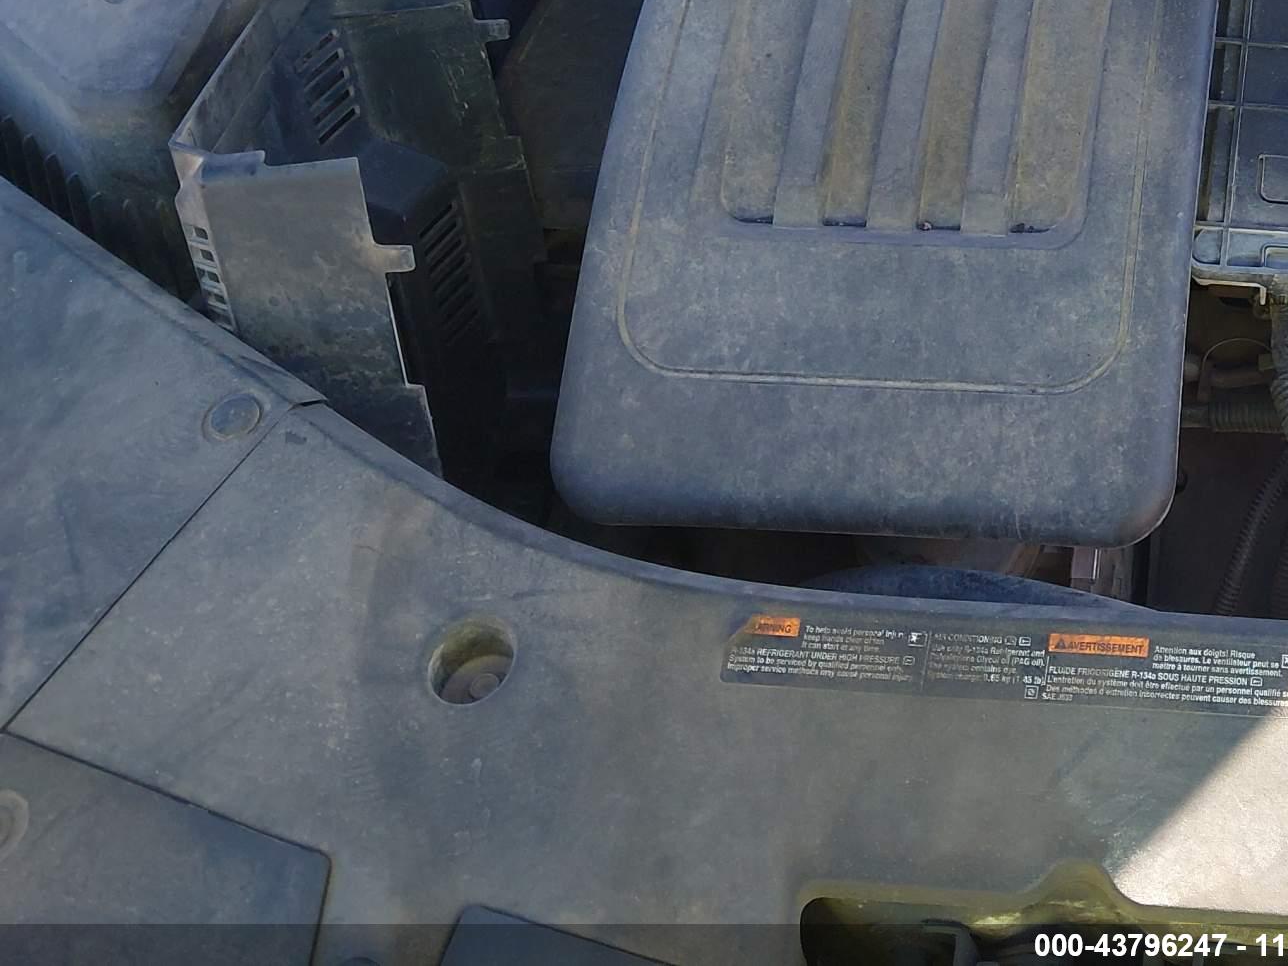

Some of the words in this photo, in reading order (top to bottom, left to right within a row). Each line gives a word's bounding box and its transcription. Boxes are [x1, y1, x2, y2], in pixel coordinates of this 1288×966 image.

[806, 625, 814, 633] To
[823, 643, 840, 651] start
[1031, 649, 1046, 658] and
[1067, 641, 1145, 654] AVERTISSEMENT
[1154, 645, 1187, 656] Attention
[1188, 648, 1202, 656] aux
[1230, 650, 1256, 661] Risque
[757, 647, 809, 658] REFRIGERANT
[811, 651, 837, 661] UNDER
[727, 662, 760, 673] Improper
[761, 665, 787, 674] service
[757, 656, 765, 664] to
[766, 656, 775, 665] be
[807, 660, 818, 669] by
[1152, 662, 1176, 670] mettre
[1183, 664, 1210, 673] tourner
[1211, 666, 1229, 674] sans
[1202, 656, 1211, 664] Le
[1213, 657, 1251, 667] ventilateur
[1252, 659, 1269, 669] peut
[1049, 665, 1076, 676] FLUIDE
[1131, 670, 1156, 680] R-134a
[1157, 672, 1180, 682] SOUS
[1181, 674, 1207, 684] HAUTE
[1208, 675, 1248, 686] PRESSION
[1087, 677, 1096, 686] du
[1191, 685, 1204, 695] par
[1205, 686, 1215, 694] un
[1216, 687, 1253, 697] personnel
[1041, 692, 1057, 701] SAE
[1181, 692, 1211, 703] peuvent
[1212, 695, 1237, 704] causer
[1238, 696, 1252, 705] des
